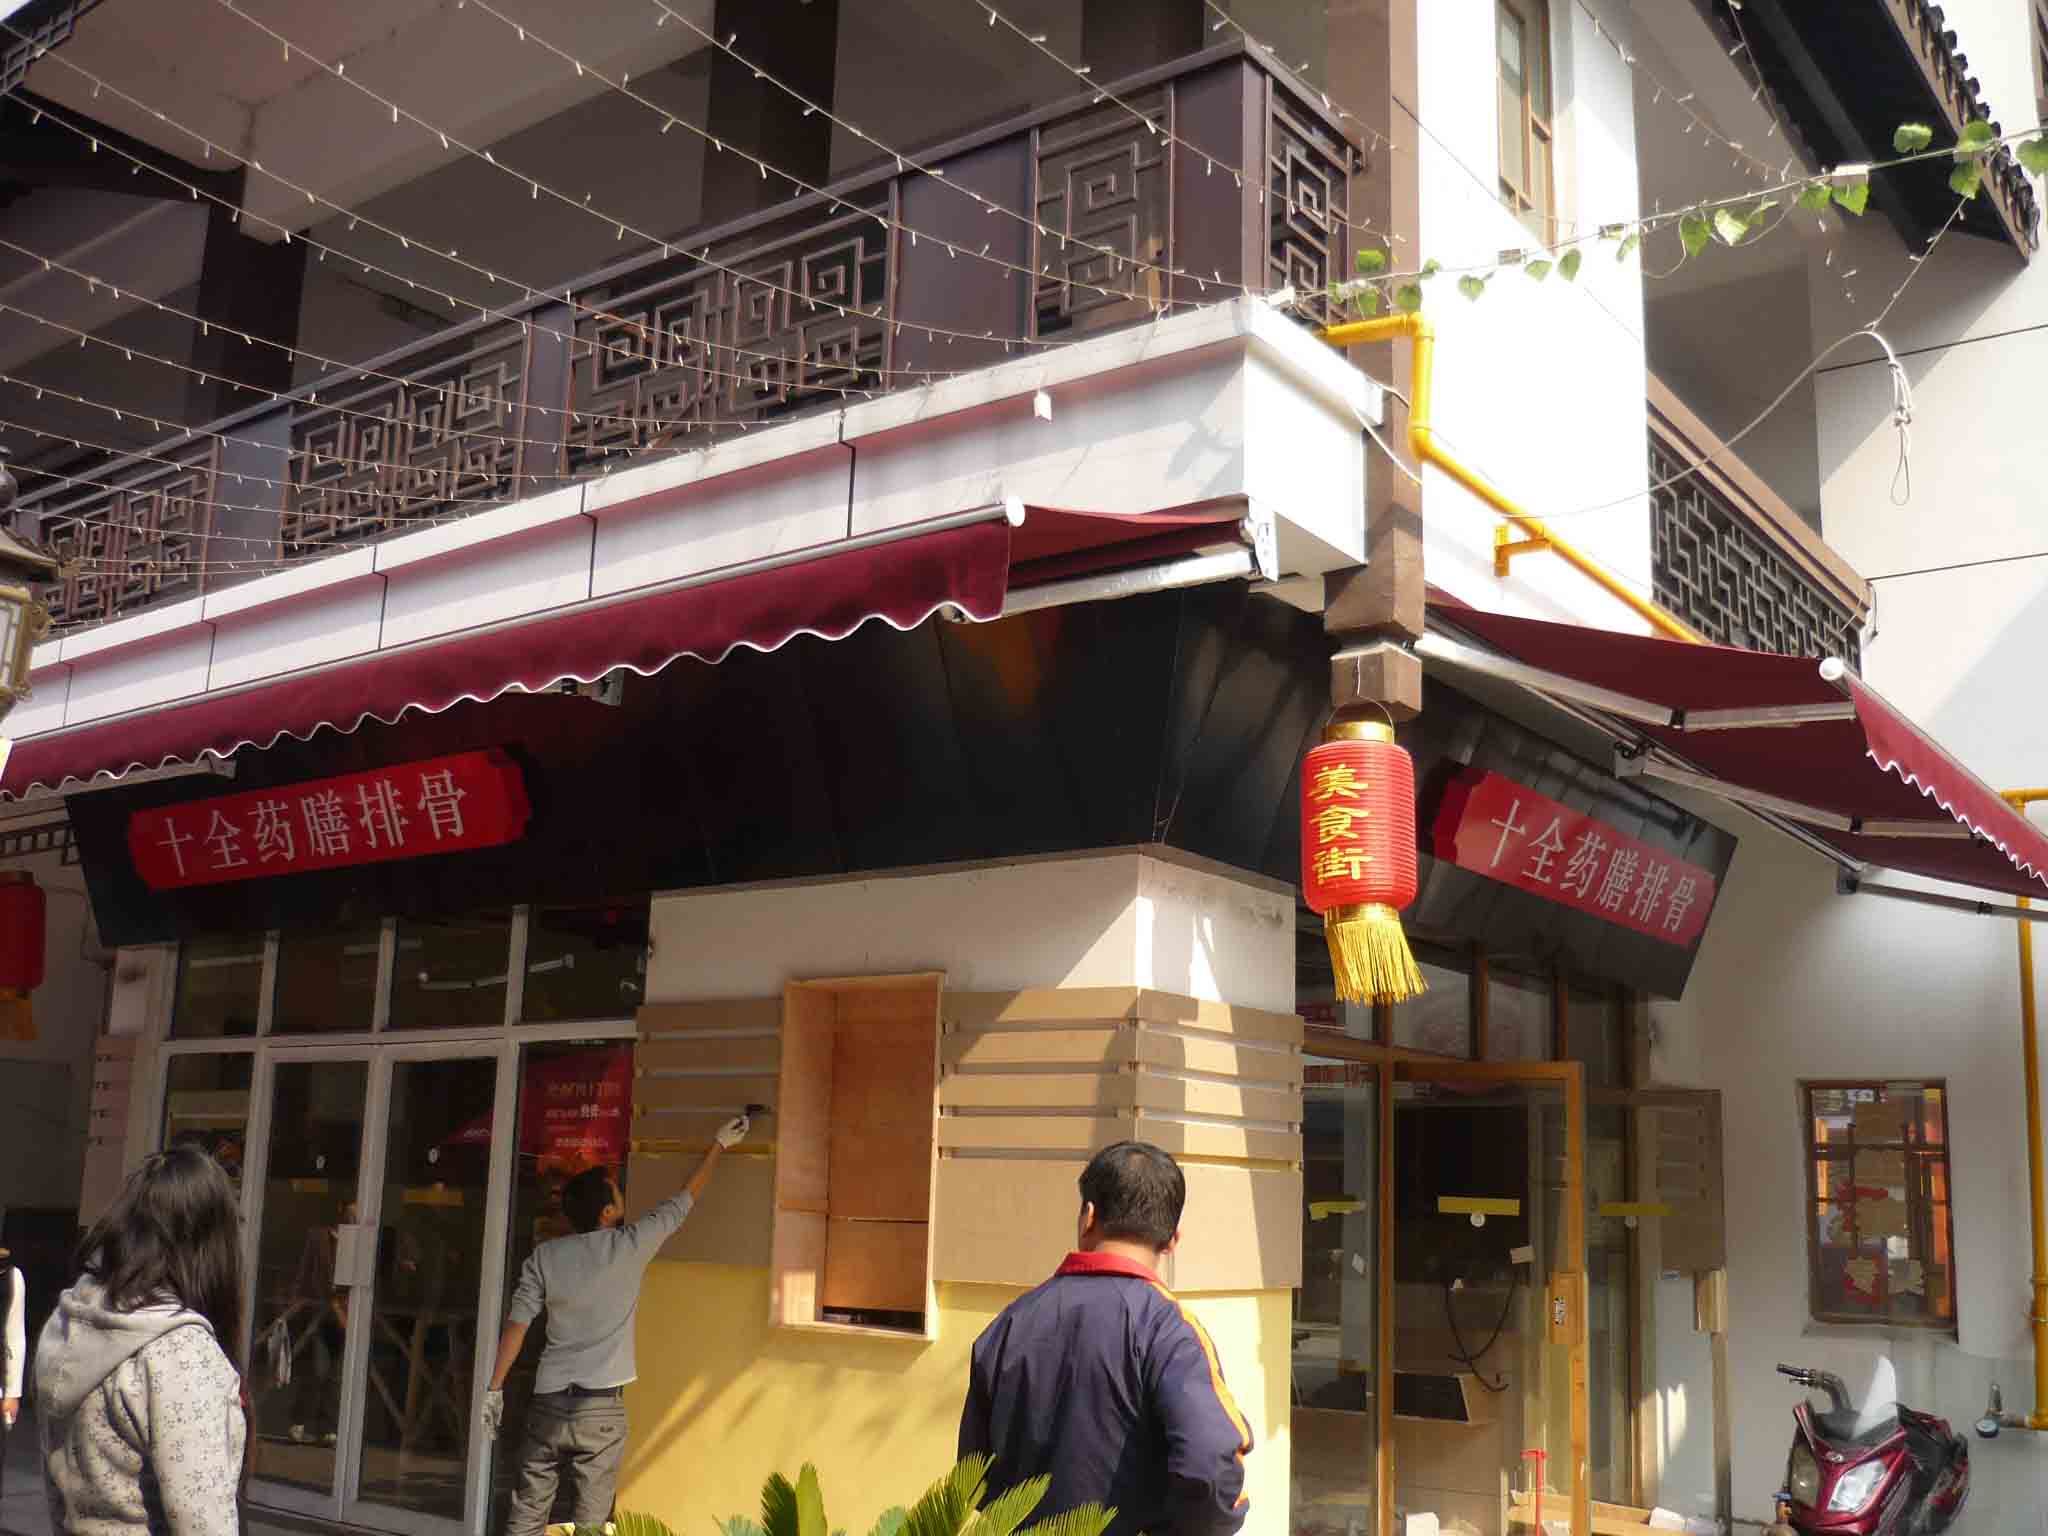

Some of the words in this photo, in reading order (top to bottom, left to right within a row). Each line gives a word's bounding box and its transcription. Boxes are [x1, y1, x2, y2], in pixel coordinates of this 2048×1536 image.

[159, 770, 466, 876] 十全药膳排骨
[1308, 764, 1375, 885] 美食街
[1491, 800, 1694, 932] 十全药膳排骨
